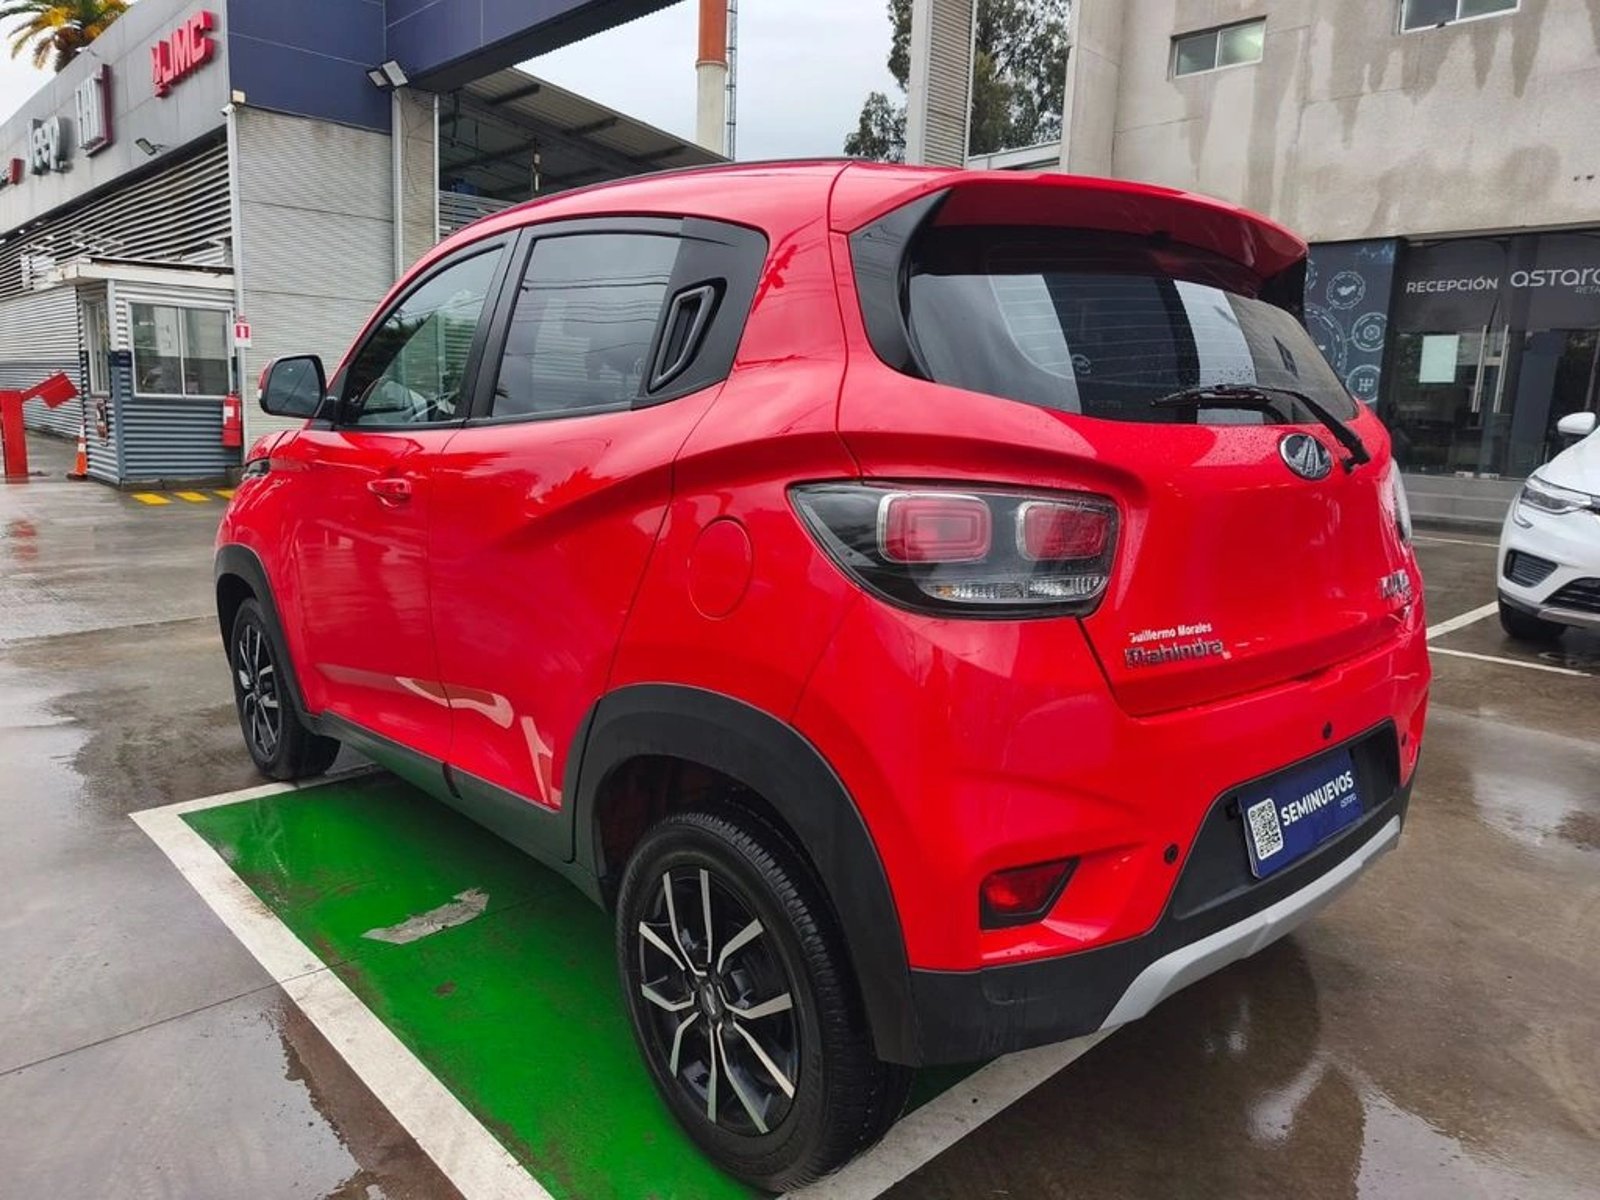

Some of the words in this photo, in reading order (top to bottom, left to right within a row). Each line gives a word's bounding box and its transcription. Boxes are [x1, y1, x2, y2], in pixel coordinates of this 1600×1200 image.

[161, 10, 213, 85] JMC
[1406, 276, 1499, 293] RECEPCIÓN
[1128, 628, 1176, 643] Guillermo
[1178, 622, 1212, 636] Morales
[1281, 770, 1354, 826] SEMINUEVOS
